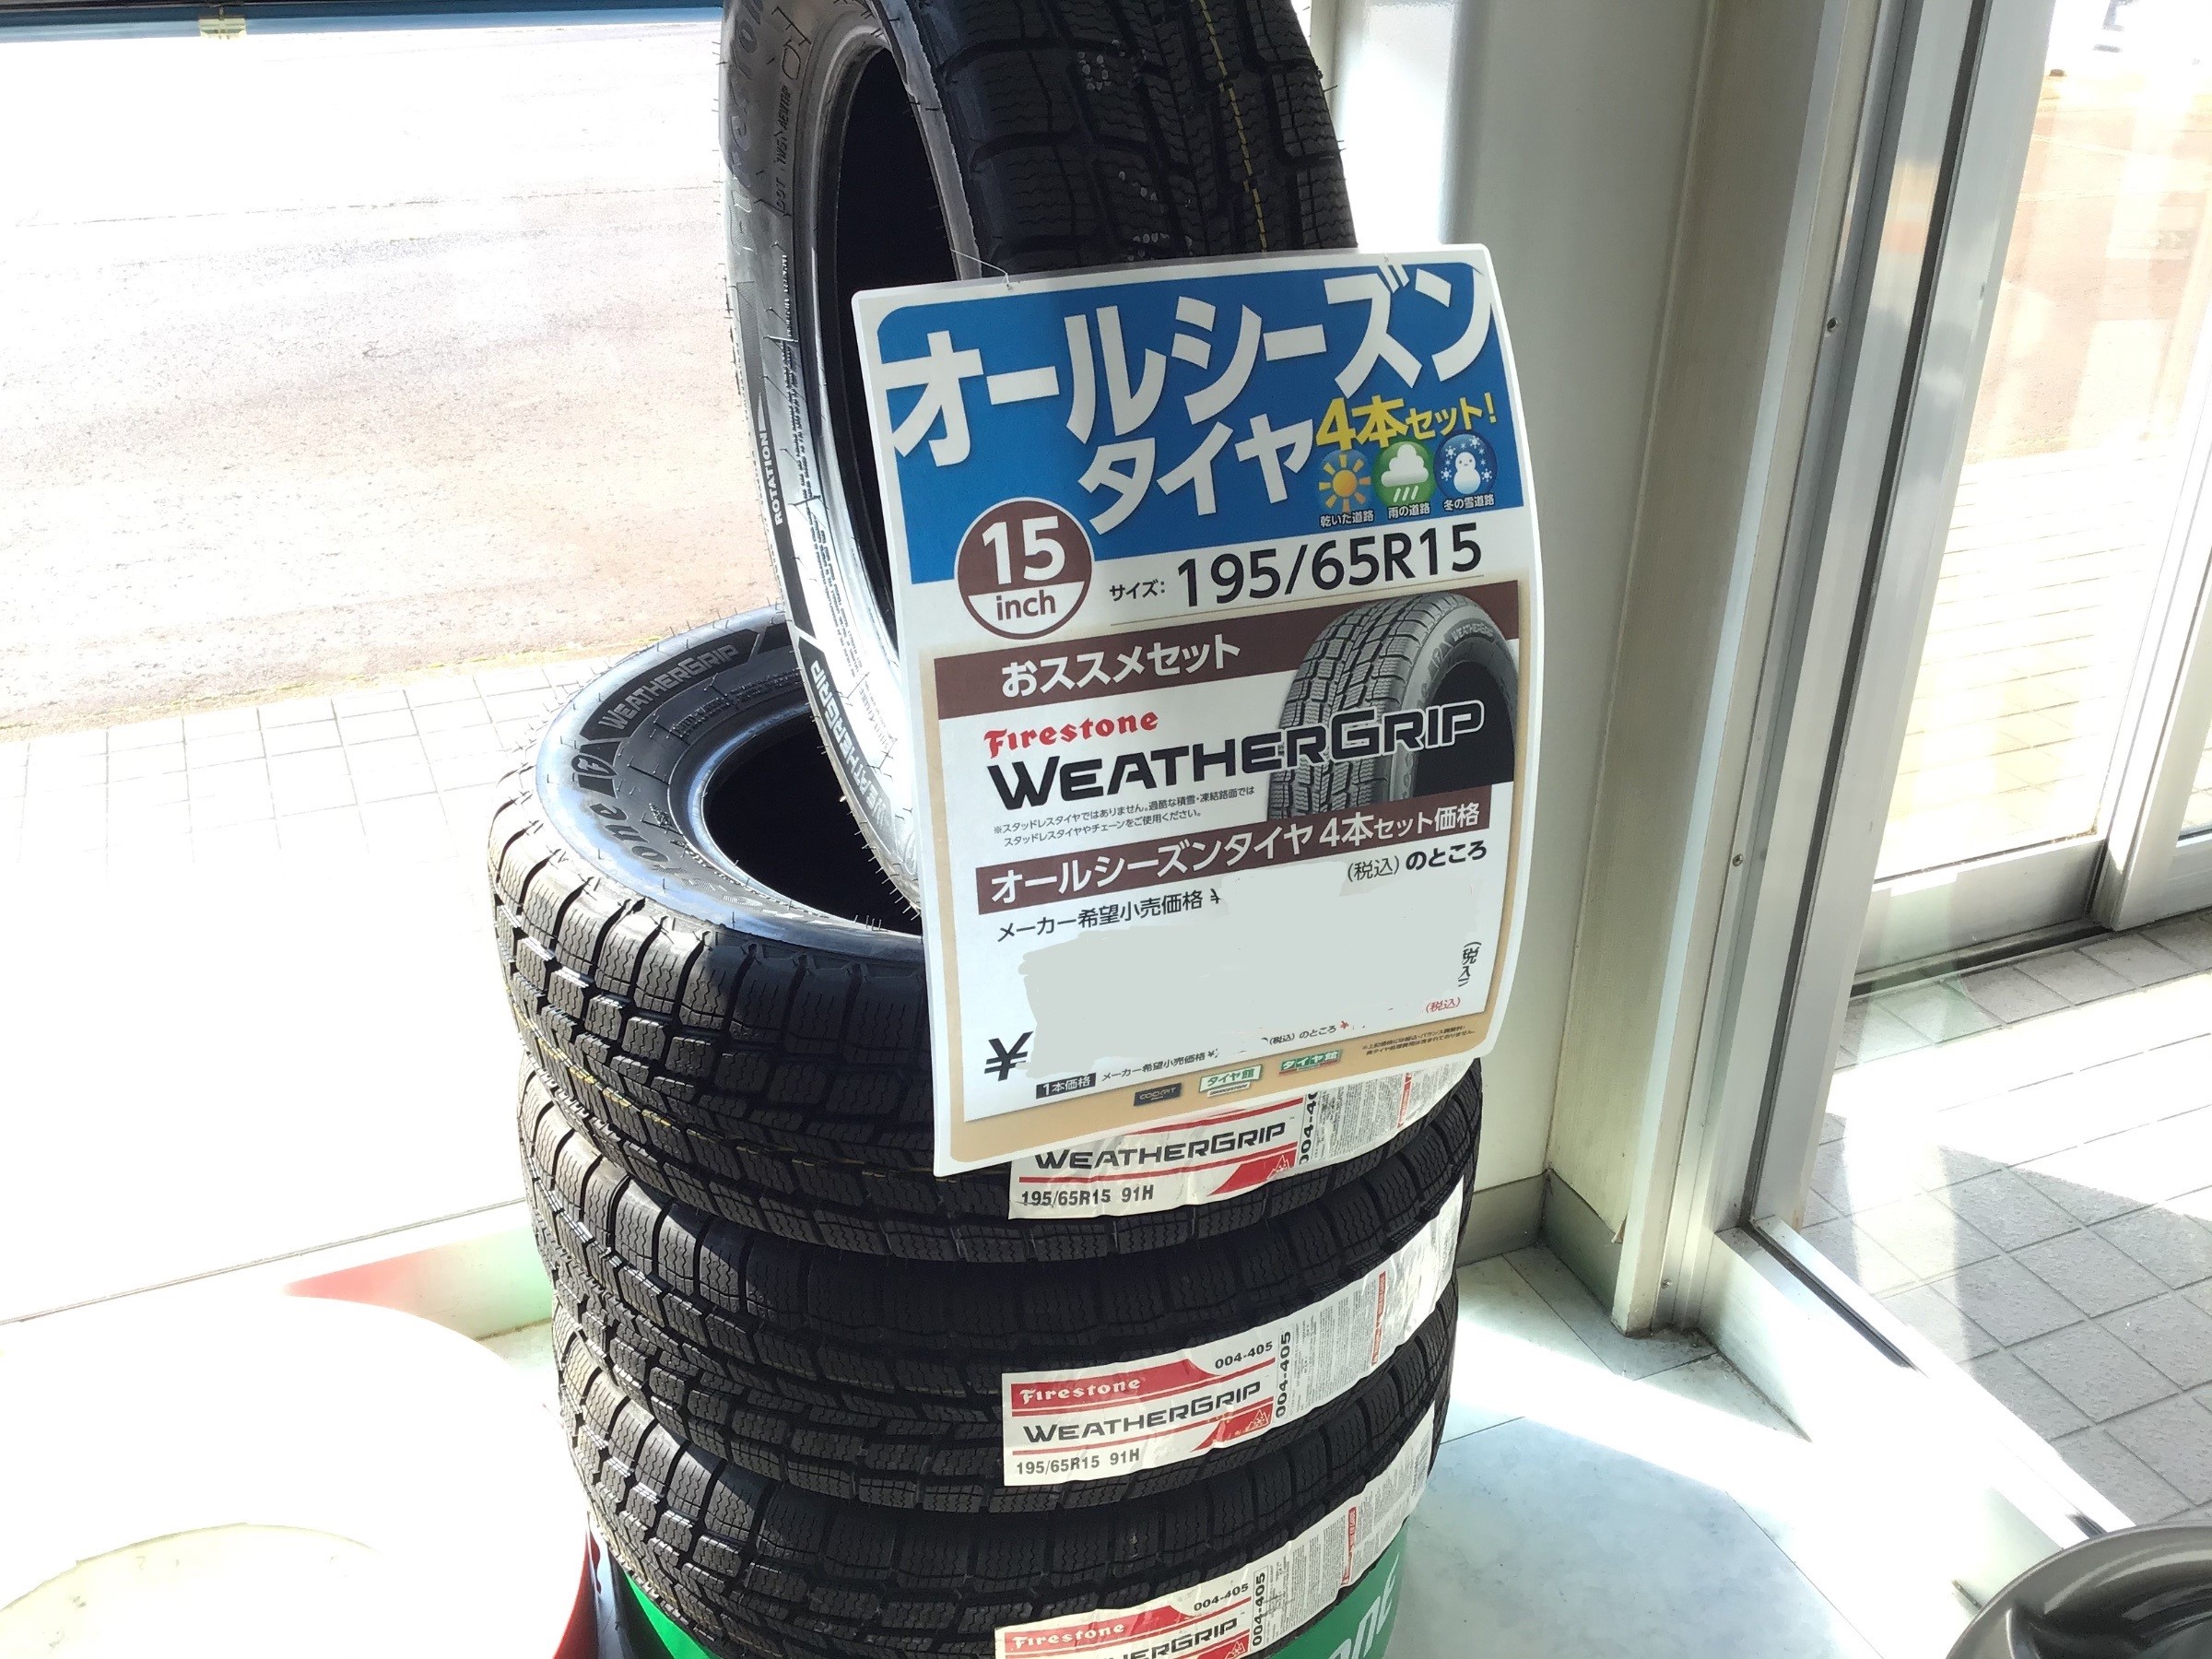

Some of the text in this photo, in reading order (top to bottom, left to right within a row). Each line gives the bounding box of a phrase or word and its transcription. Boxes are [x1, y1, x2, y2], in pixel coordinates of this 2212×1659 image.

[880, 262, 1495, 468] オールシーズン
[1315, 392, 1498, 452] 4本セット!
[759, 429, 784, 527] ROTATION
[1077, 413, 1314, 535] タイヤ
[1320, 510, 1375, 528] 乾いた道路
[1387, 502, 1430, 519] 雨の道路
[1443, 493, 1495, 512] 冬の雪道路
[982, 515, 1066, 586] 15
[1177, 522, 1483, 608] 195/65R15
[995, 590, 1056, 621] inch
[597, 643, 739, 730] WEATHERGRIP
[1001, 633, 1241, 699] おススメセット
[983, 711, 1159, 759] Firestone
[986, 699, 1485, 811] WEATHERGRIP
[983, 1030, 1034, 1082] ¥
[1207, 1066, 1254, 1088] タイヤ館
[1042, 1075, 1091, 1097] 1本価格
[1035, 1122, 1287, 1170] WEATHERGRIP
[1020, 1186, 1154, 1206] 195/65R15 91H
[1214, 1341, 1274, 1370] 004-405
[1275, 1331, 1291, 1418] 004-405
[1019, 1378, 1141, 1405] Firestone
[1023, 1381, 1261, 1443] WEATHERGRIP
[1016, 1448, 1140, 1476] 195/65R15 91H
[1194, 1583, 1249, 1612] 004-405
[1252, 1572, 1266, 1647] 004-405
[1011, 1623, 1125, 1650] Firestone
